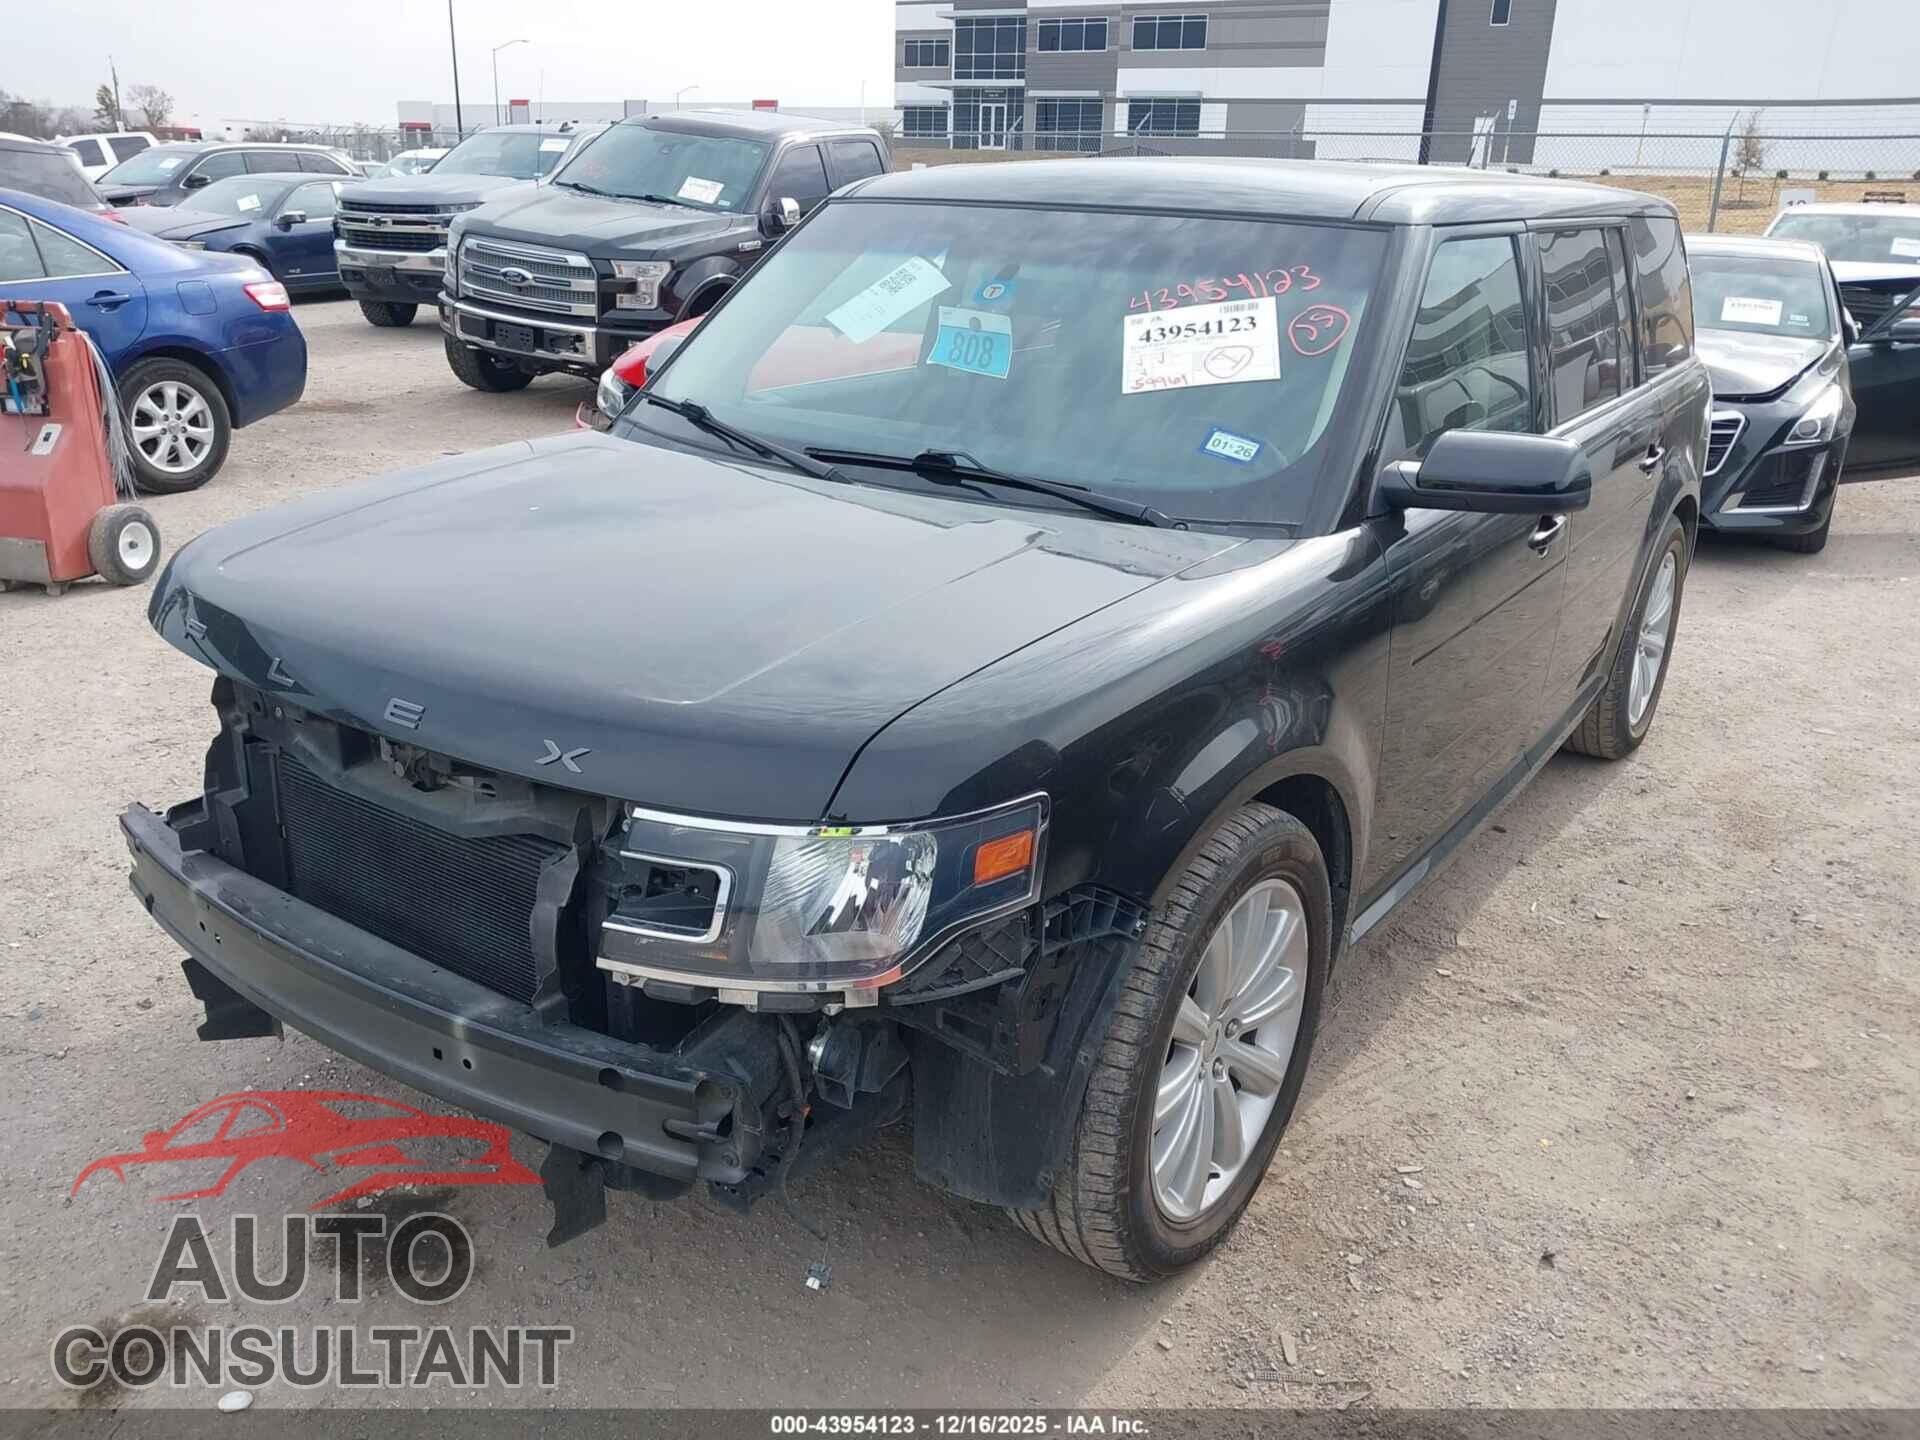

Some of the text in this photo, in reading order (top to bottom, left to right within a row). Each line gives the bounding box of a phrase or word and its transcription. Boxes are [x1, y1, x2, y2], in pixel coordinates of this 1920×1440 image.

[1130, 265, 1321, 312] 43954123
[949, 331, 994, 368] 808
[1138, 315, 1257, 344] 43954123
[185, 617, 592, 774] FLEX
